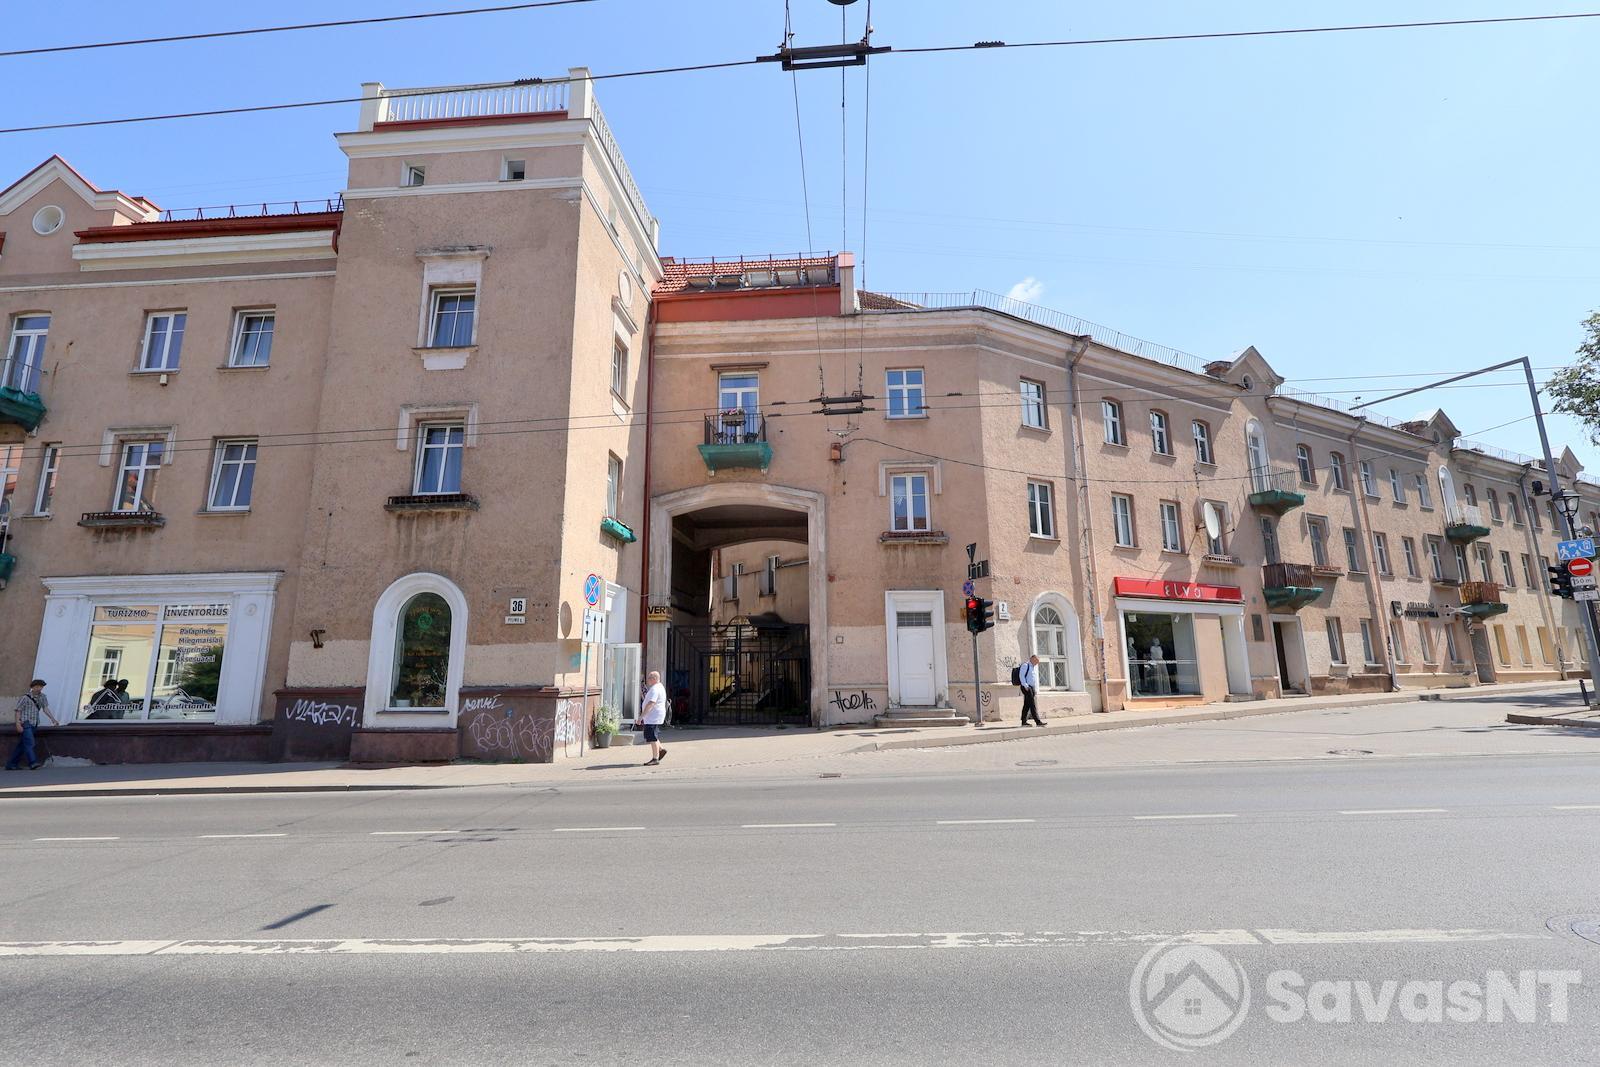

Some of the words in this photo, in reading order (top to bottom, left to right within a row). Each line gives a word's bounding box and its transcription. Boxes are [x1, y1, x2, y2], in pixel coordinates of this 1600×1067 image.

[512, 600, 523, 611] 36
[107, 609, 148, 618] TURIZMO
[166, 608, 228, 617] INVENTORIUS
